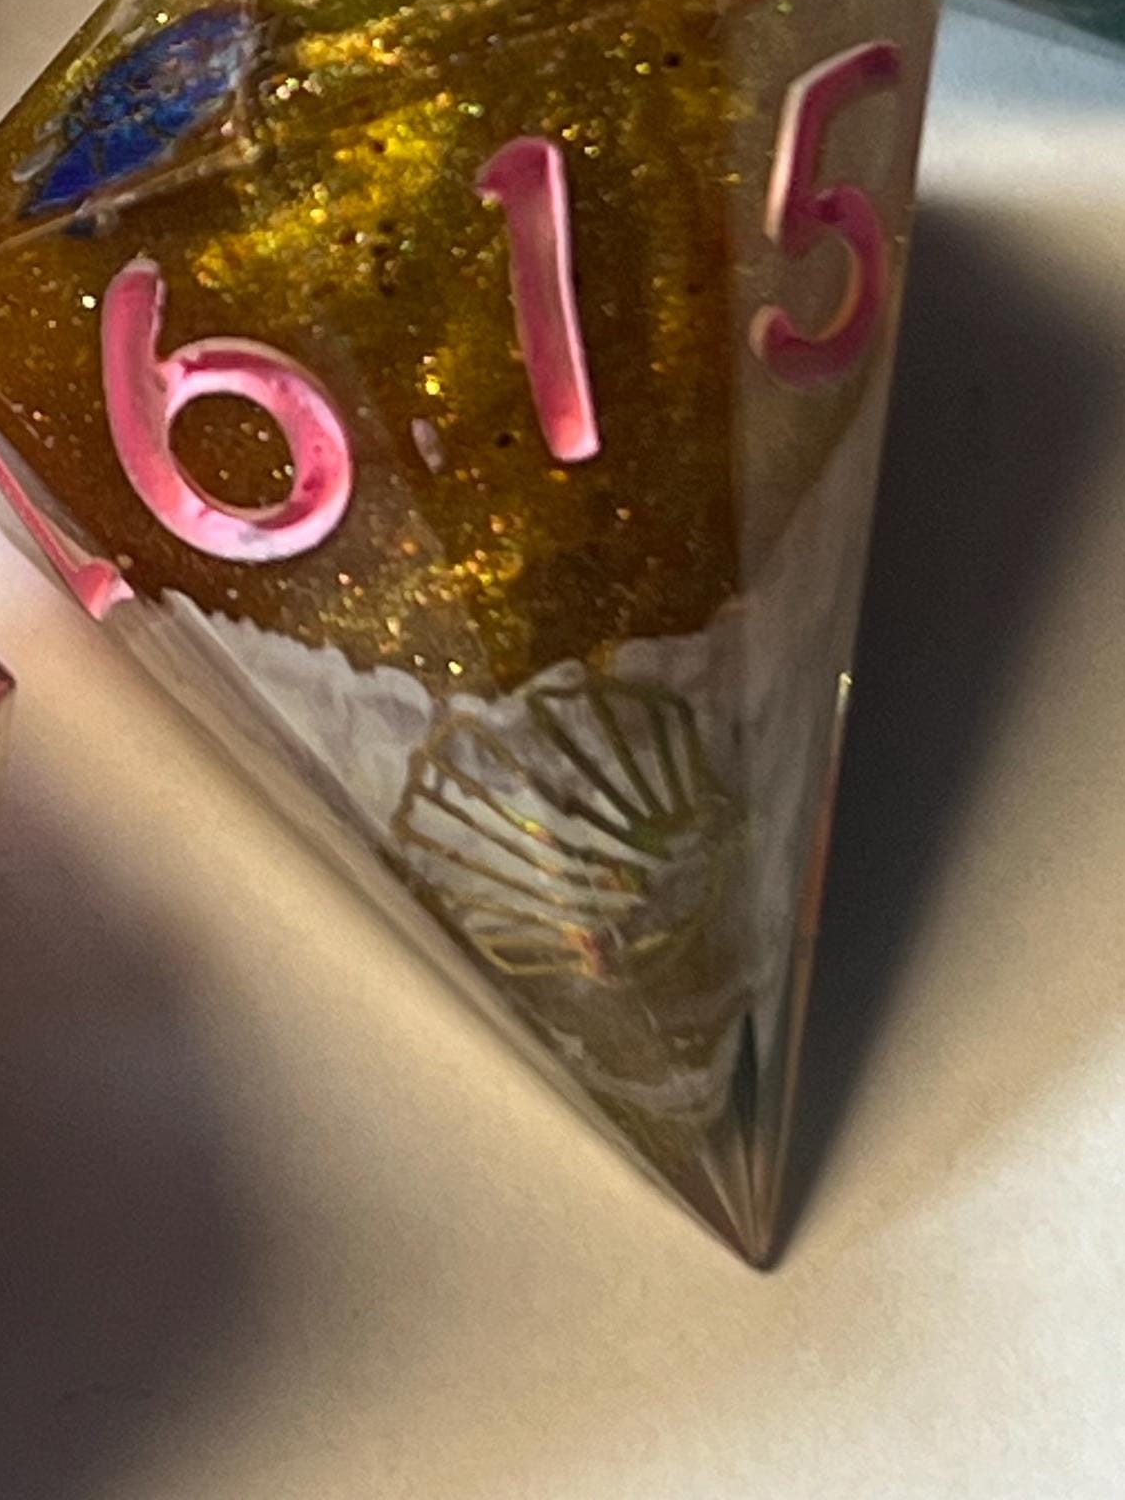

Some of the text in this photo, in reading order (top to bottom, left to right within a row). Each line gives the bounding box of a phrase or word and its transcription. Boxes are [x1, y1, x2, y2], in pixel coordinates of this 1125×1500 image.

[478, 139, 600, 462] 1
[751, 43, 900, 385] 5
[102, 260, 353, 560] 6
